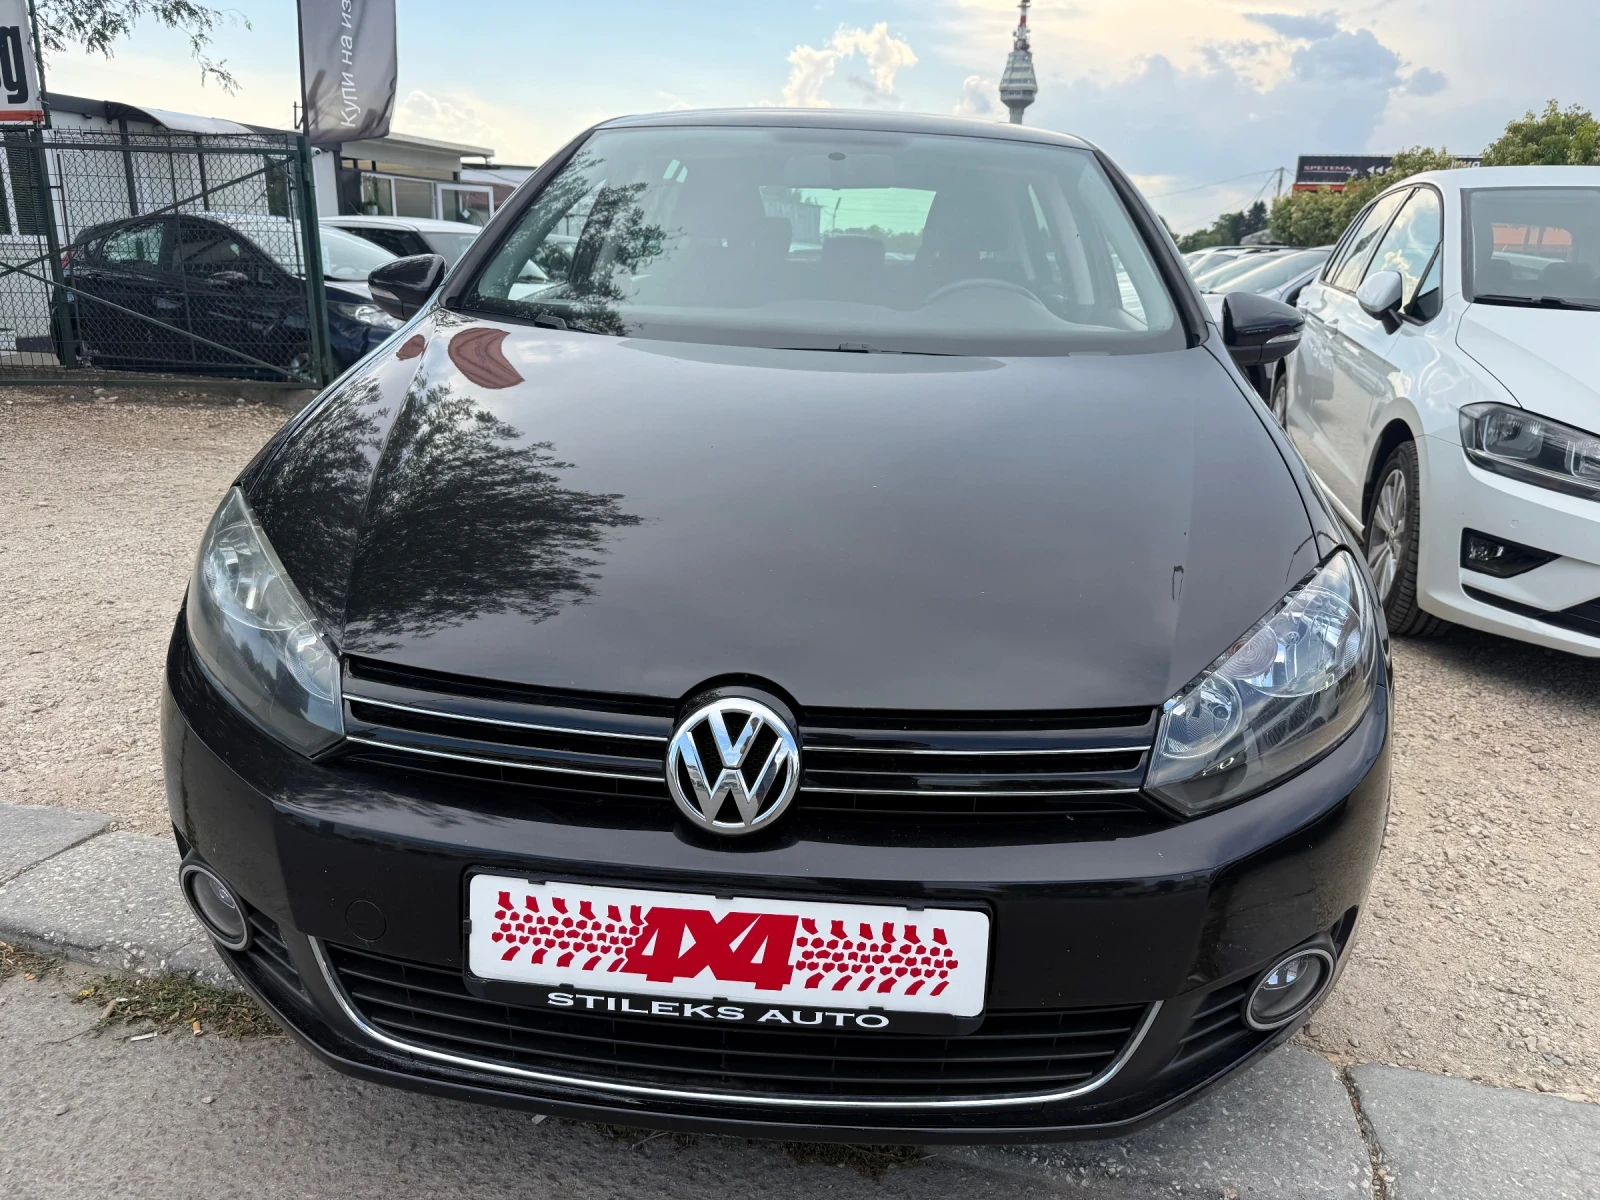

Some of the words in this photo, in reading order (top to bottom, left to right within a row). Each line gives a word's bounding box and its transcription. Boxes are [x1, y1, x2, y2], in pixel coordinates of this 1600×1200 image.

[340, 35, 353, 65] на
[340, 71, 361, 127] Купи
[547, 992, 745, 1021] STILEKS
[758, 1009, 890, 1028] AUTO
